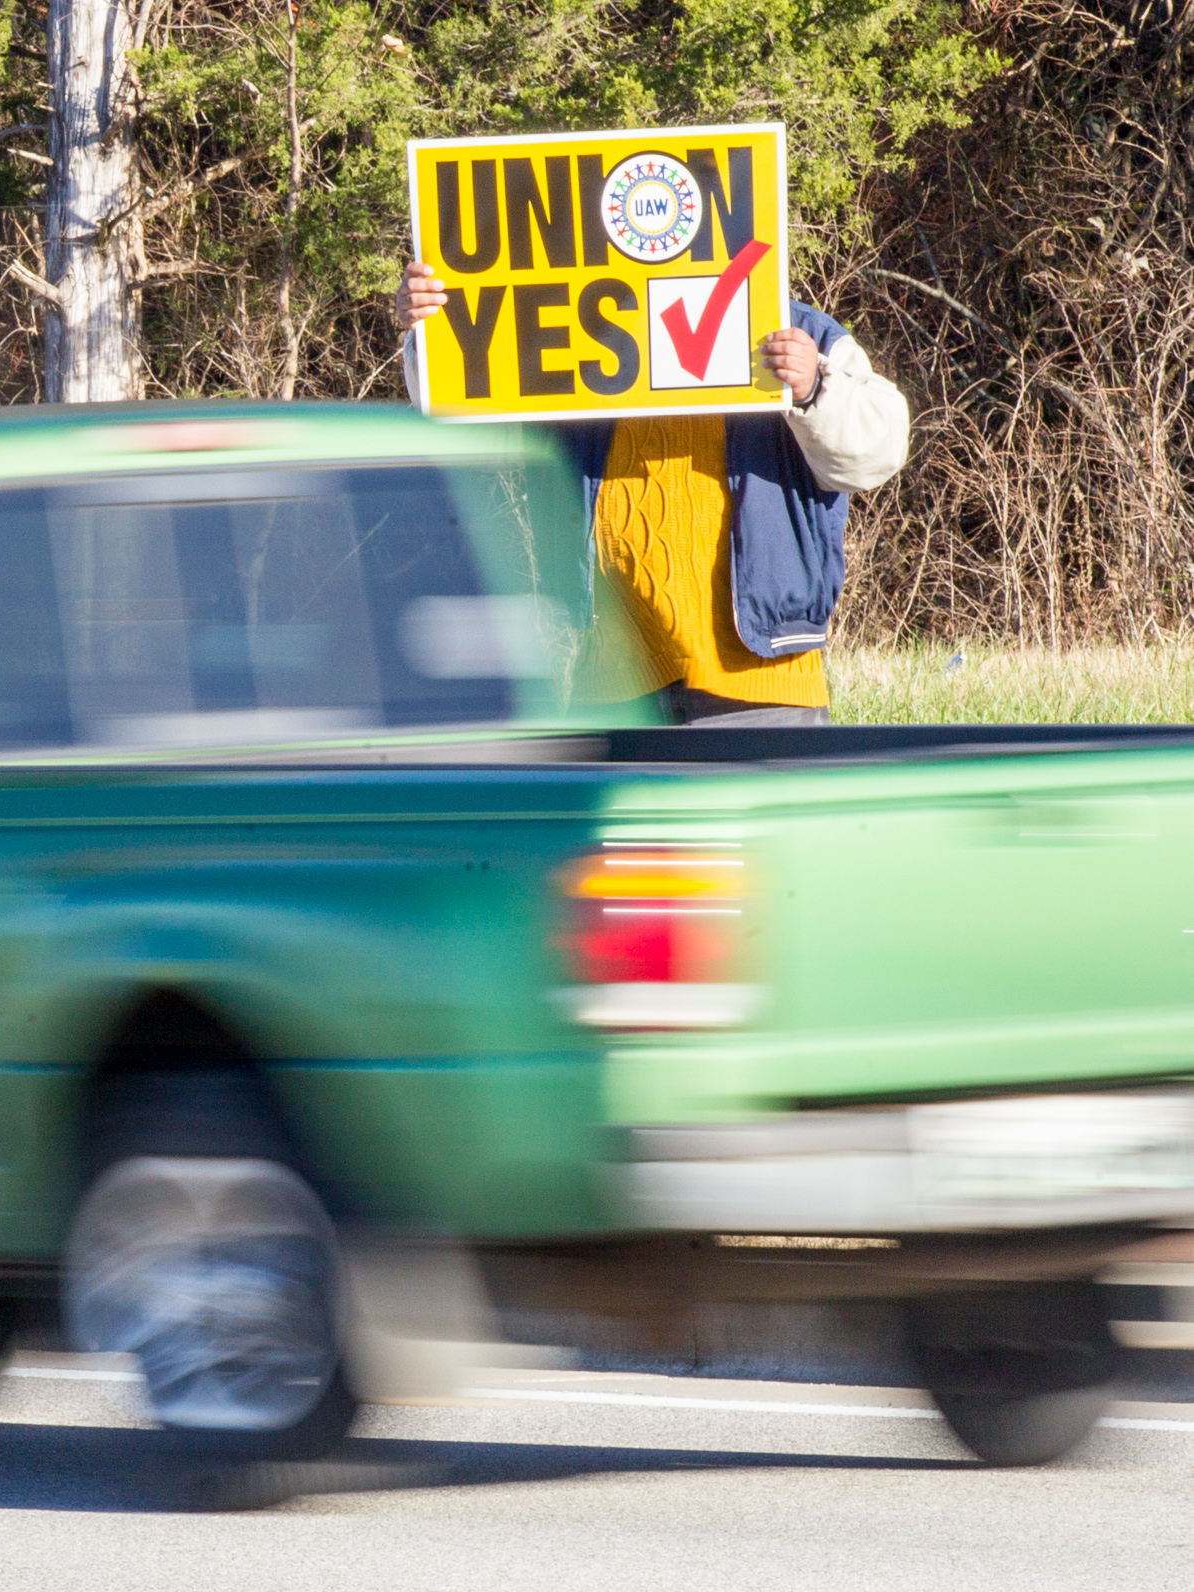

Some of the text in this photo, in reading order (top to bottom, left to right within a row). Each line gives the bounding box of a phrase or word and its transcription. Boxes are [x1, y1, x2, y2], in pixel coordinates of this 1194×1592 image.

[436, 146, 755, 274] UNION
[635, 199, 669, 216] UAW
[442, 278, 641, 399] YES
